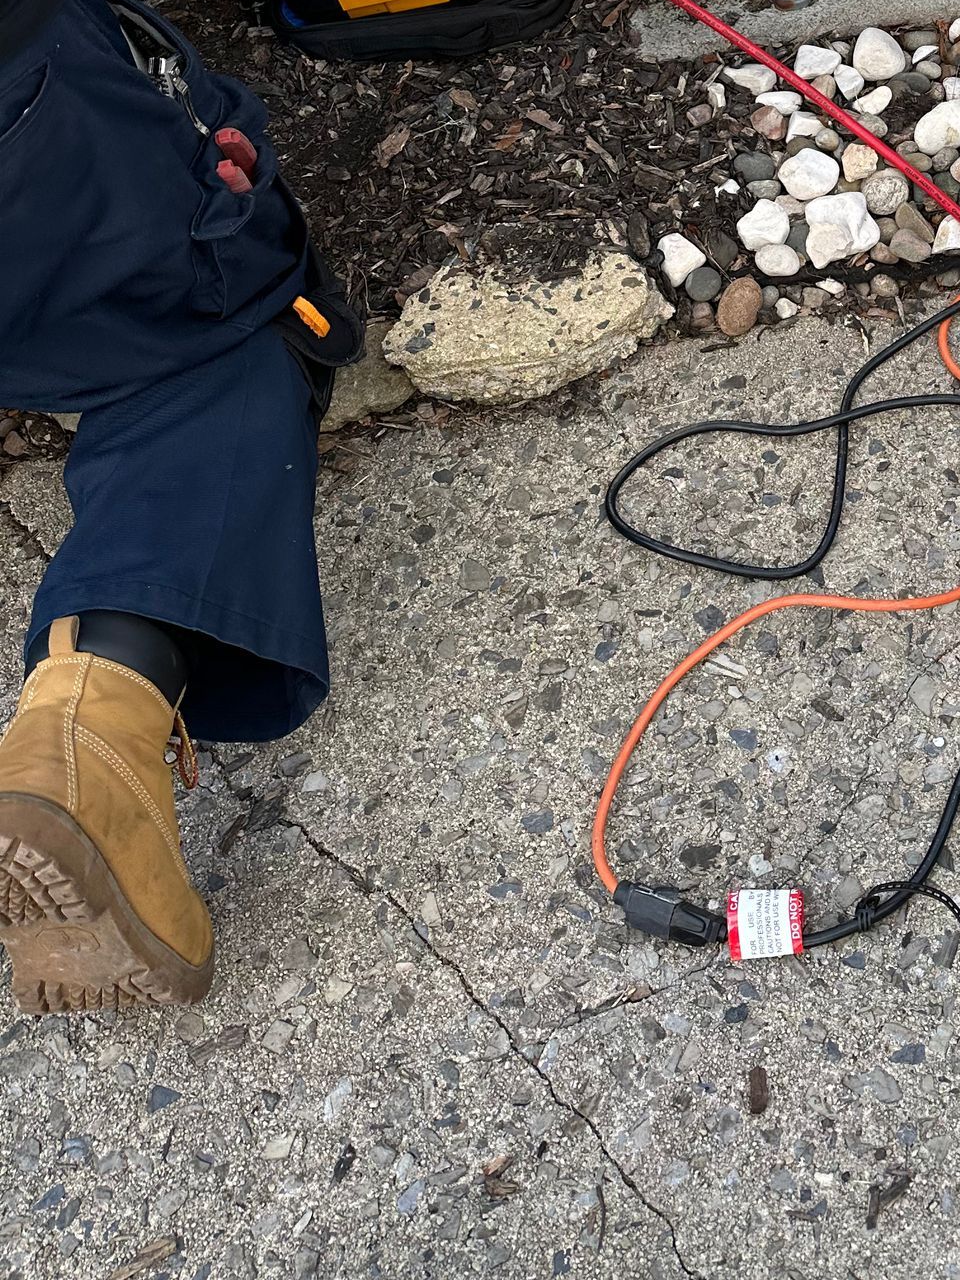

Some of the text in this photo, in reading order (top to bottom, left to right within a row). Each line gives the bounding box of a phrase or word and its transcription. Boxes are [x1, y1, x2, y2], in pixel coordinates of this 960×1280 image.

[904, 167, 918, 179] YELLOW
[918, 179, 933, 191] JACKET
[789, 897, 798, 920] NOT
[756, 893, 765, 955] PROFESSIONALS
[765, 916, 774, 954] CAUTIONS
[791, 923, 801, 939] DO
